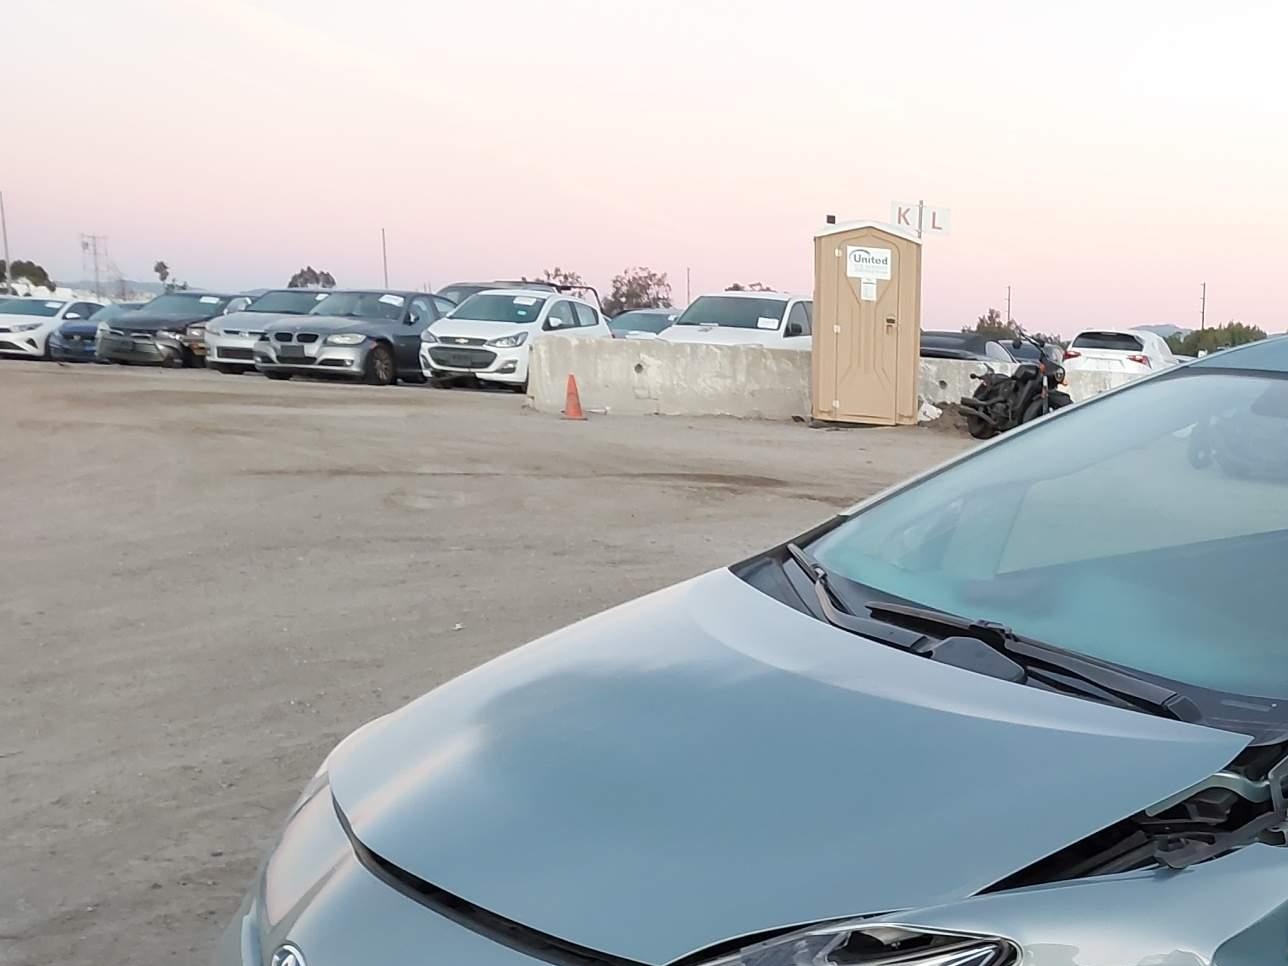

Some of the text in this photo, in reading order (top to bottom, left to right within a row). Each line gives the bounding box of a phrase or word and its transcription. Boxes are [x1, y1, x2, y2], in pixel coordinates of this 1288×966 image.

[897, 206, 911, 226] K
[931, 211, 943, 230] L
[853, 254, 888, 265] United
